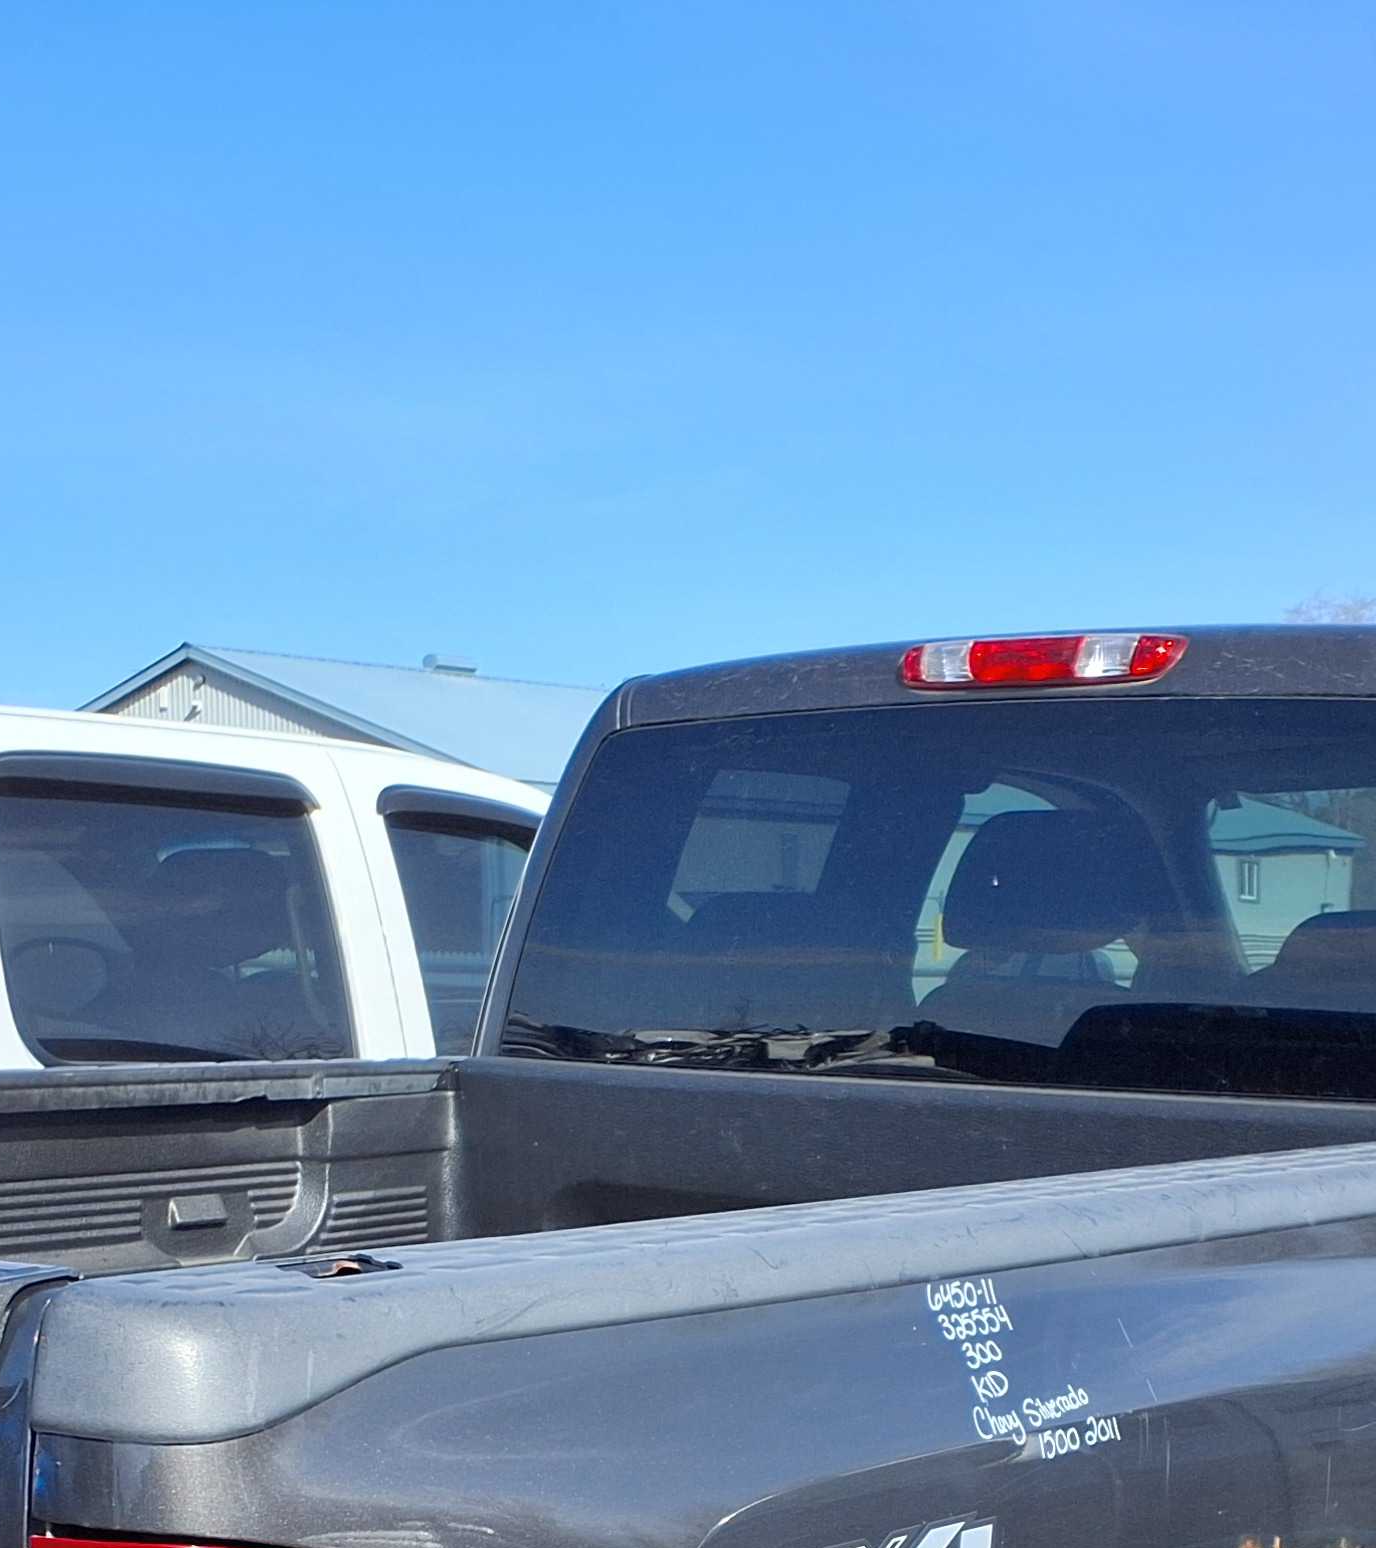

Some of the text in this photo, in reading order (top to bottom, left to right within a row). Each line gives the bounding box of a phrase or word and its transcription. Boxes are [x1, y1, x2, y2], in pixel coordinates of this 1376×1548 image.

[927, 1278, 997, 1311] 6450-11
[962, 1341, 1002, 1369] 300
[1039, 1416, 1121, 1460] 1500 2011
